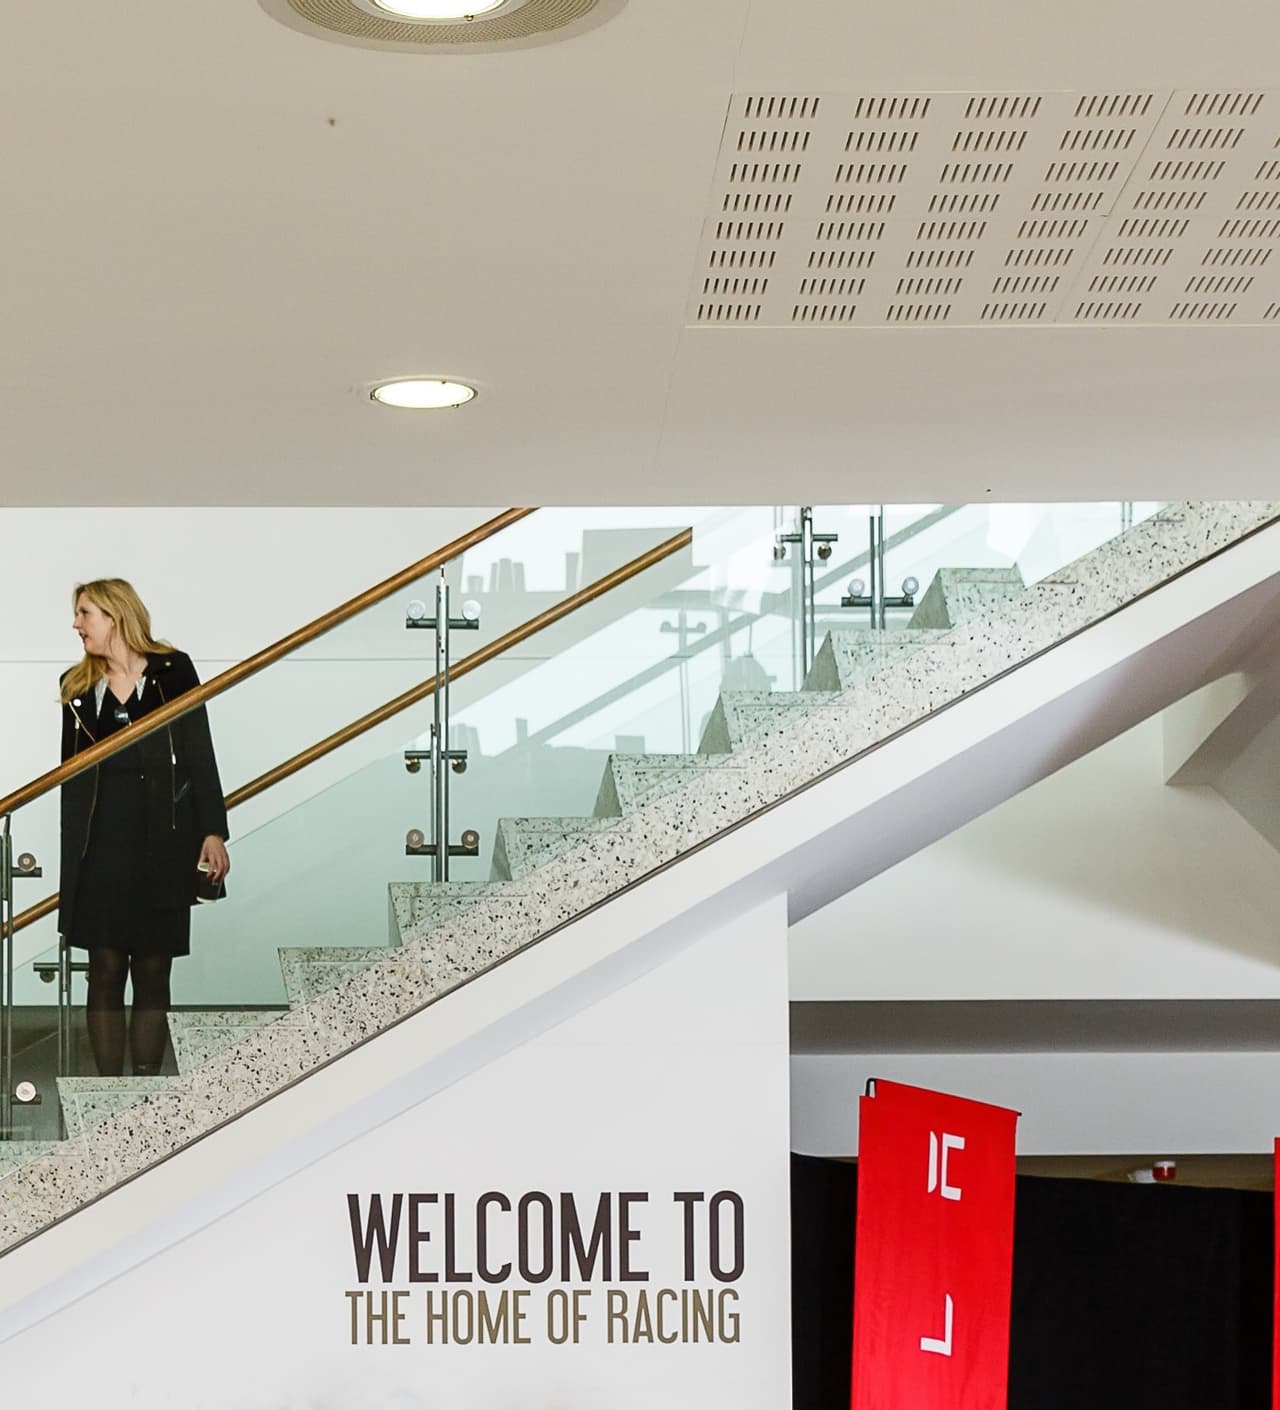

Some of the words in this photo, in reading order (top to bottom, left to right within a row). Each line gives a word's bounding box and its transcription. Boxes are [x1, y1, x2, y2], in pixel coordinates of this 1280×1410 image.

[346, 1191, 650, 1284] WELCOME
[672, 1189, 745, 1283] TO
[345, 1290, 411, 1345] THE
[426, 1289, 531, 1345] HOME
[547, 1289, 592, 1345] OF
[607, 1288, 742, 1344] RACING
